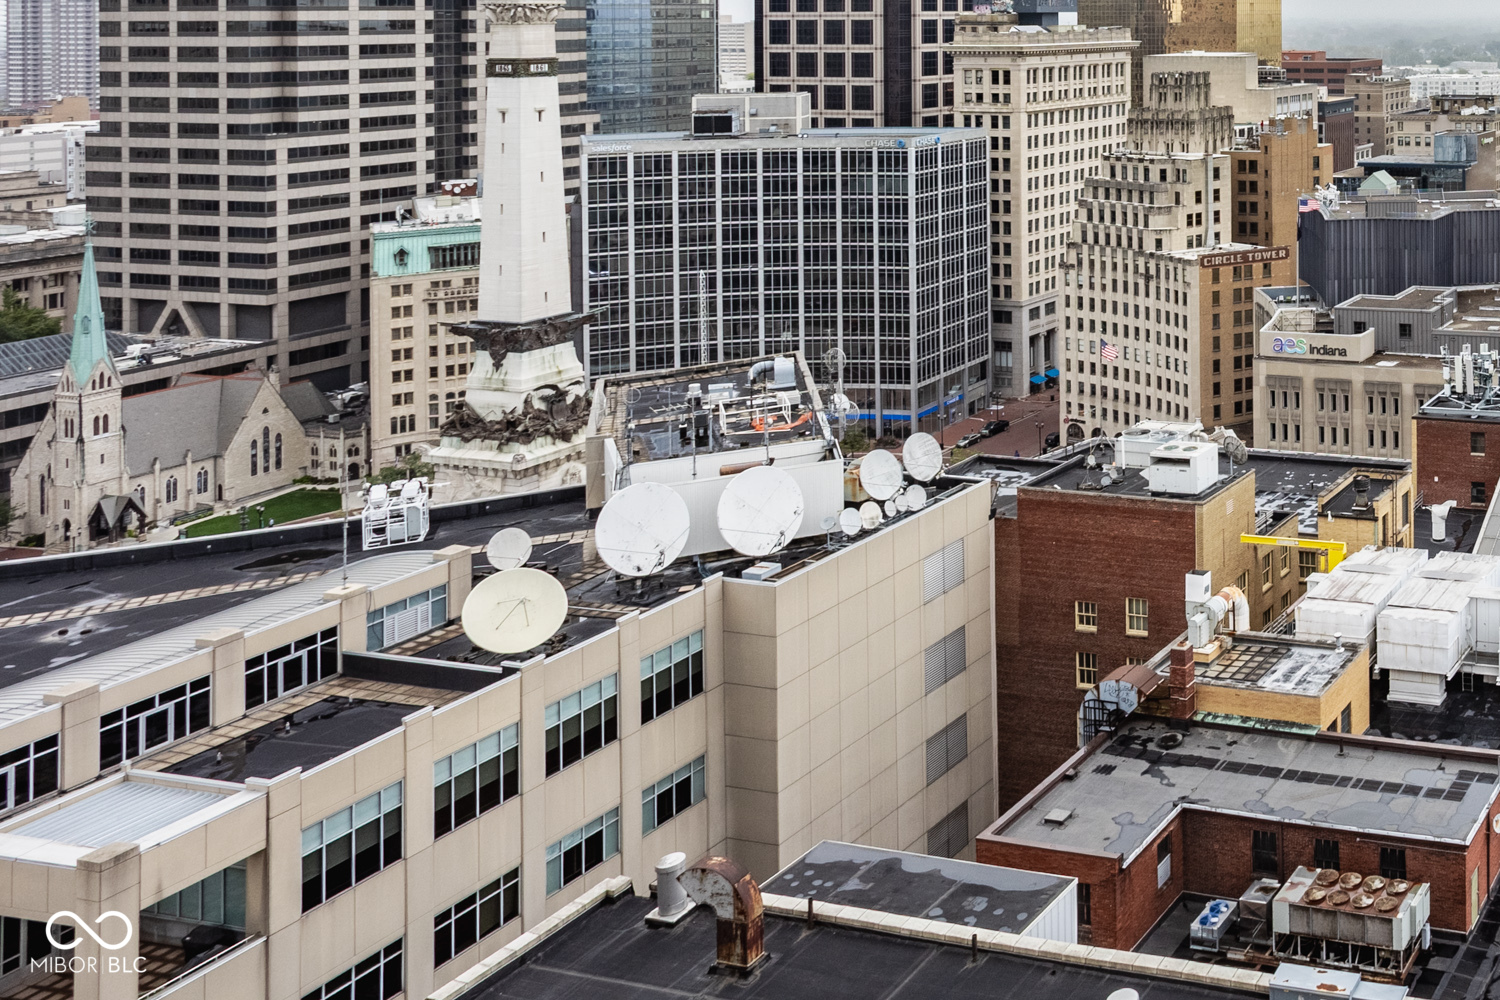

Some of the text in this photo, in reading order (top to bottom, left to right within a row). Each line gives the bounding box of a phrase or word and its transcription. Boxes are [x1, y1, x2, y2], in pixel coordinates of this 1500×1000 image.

[864, 139, 896, 147] CHASE
[916, 137, 935, 146] CHASE
[591, 144, 632, 153] salesforce
[1203, 249, 1286, 266] CIRCLE TOWER
[1272, 337, 1347, 356] aes Indiana
